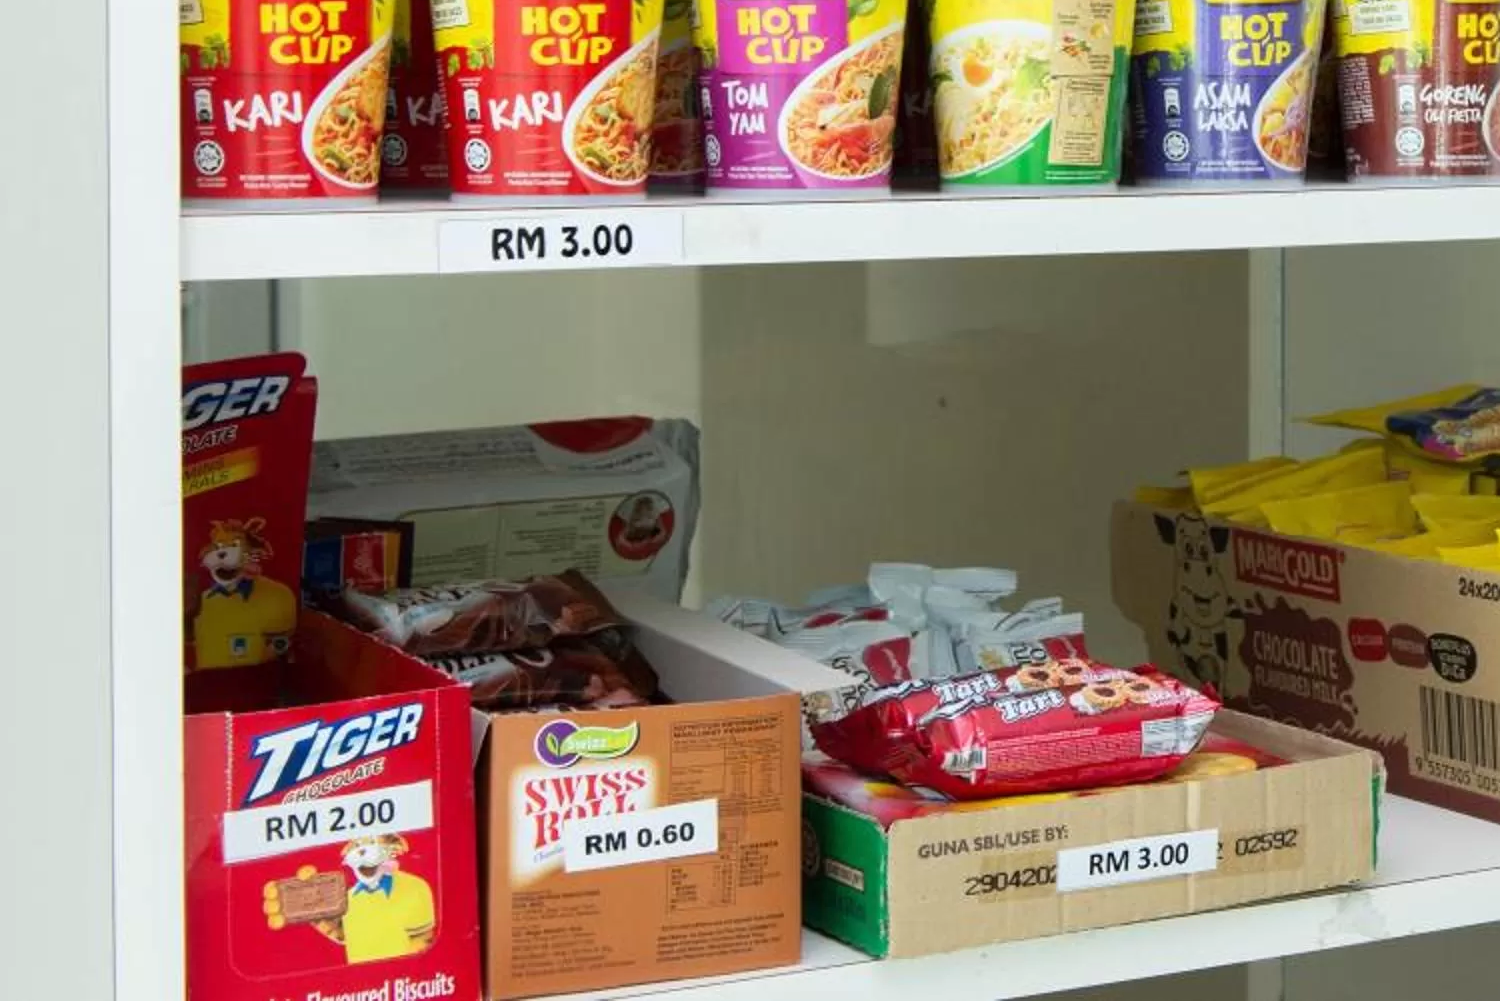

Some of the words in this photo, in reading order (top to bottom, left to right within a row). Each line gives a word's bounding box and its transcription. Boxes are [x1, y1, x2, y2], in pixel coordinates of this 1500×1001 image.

[259, 0, 348, 35] HOT
[520, 3, 608, 36] HOT
[736, 4, 818, 37] HOT
[1219, 11, 1289, 41] HOT
[269, 34, 354, 65] CUP
[529, 36, 614, 66] CUP
[746, 35, 826, 65] CUP
[1227, 39, 1292, 68] CUP
[720, 79, 769, 110] TOM
[1193, 80, 1252, 110] ASAM
[1418, 82, 1486, 106] GORENG
[222, 90, 303, 133] KARI
[488, 90, 565, 132] KARI
[729, 112, 767, 137] YAM
[1197, 108, 1249, 133] LAKSA
[491, 226, 546, 261] RM
[560, 223, 633, 258] 3.00
[182, 374, 291, 431] GER
[1237, 536, 1335, 589] MARIGOLD
[1252, 629, 1340, 682] CHOCOLATE
[932, 672, 1002, 703] Tart
[1253, 666, 1312, 697] FLAVOURED
[994, 689, 1066, 724] Tart
[247, 703, 424, 803] TIGER
[284, 757, 386, 805] CHOCOLATE
[524, 767, 648, 816] SWISS
[264, 810, 318, 843] RM
[328, 798, 396, 833] 2.00
[584, 829, 628, 856] RM
[636, 821, 696, 849] 0.60
[917, 838, 970, 860] GUNA
[972, 828, 1041, 853] SBL/USE
[1043, 824, 1070, 842] BY:
[1234, 828, 1299, 857] 02592
[1088, 850, 1130, 876] RM
[1136, 842, 1190, 871] 3.00
[394, 971, 456, 1000] Biscuits
